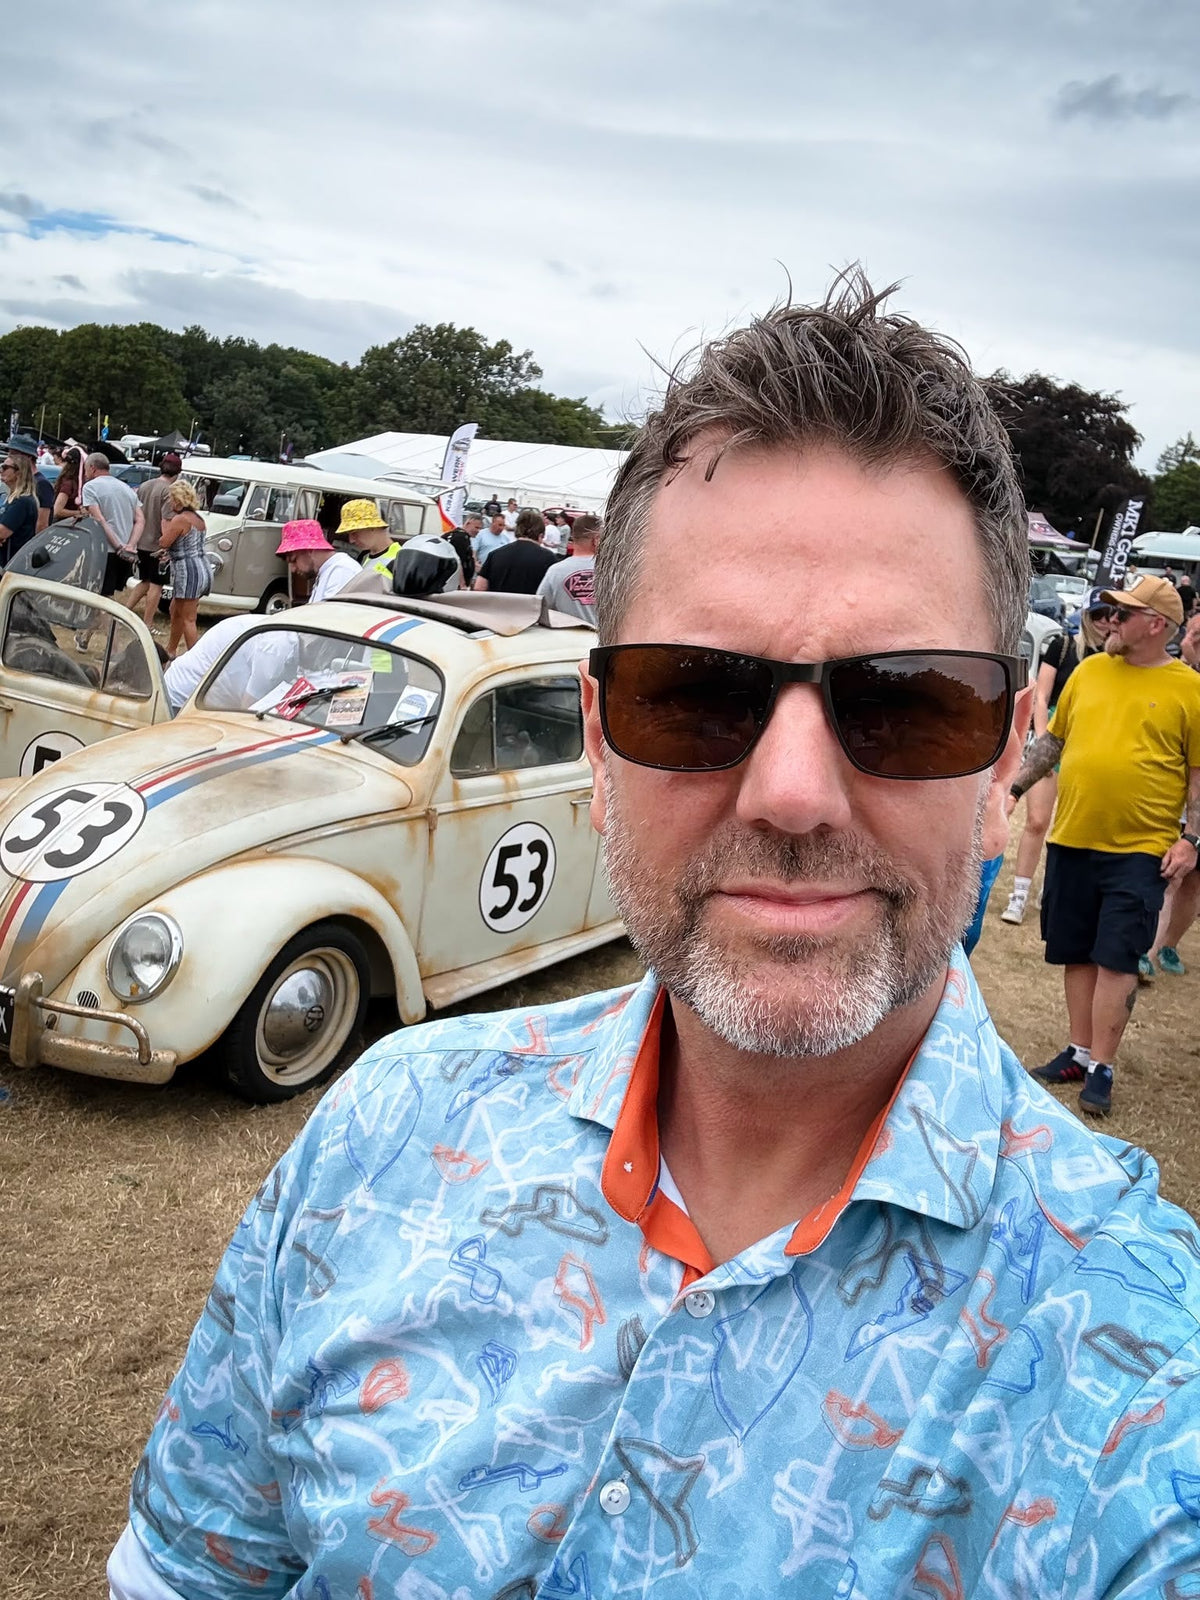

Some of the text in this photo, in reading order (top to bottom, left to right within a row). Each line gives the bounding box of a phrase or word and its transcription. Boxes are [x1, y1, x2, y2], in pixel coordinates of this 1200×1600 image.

[445, 456, 462, 512] KRAWERK
[1103, 547, 1114, 568] CLUB
[5, 789, 133, 868] 53
[489, 839, 549, 920] 53
